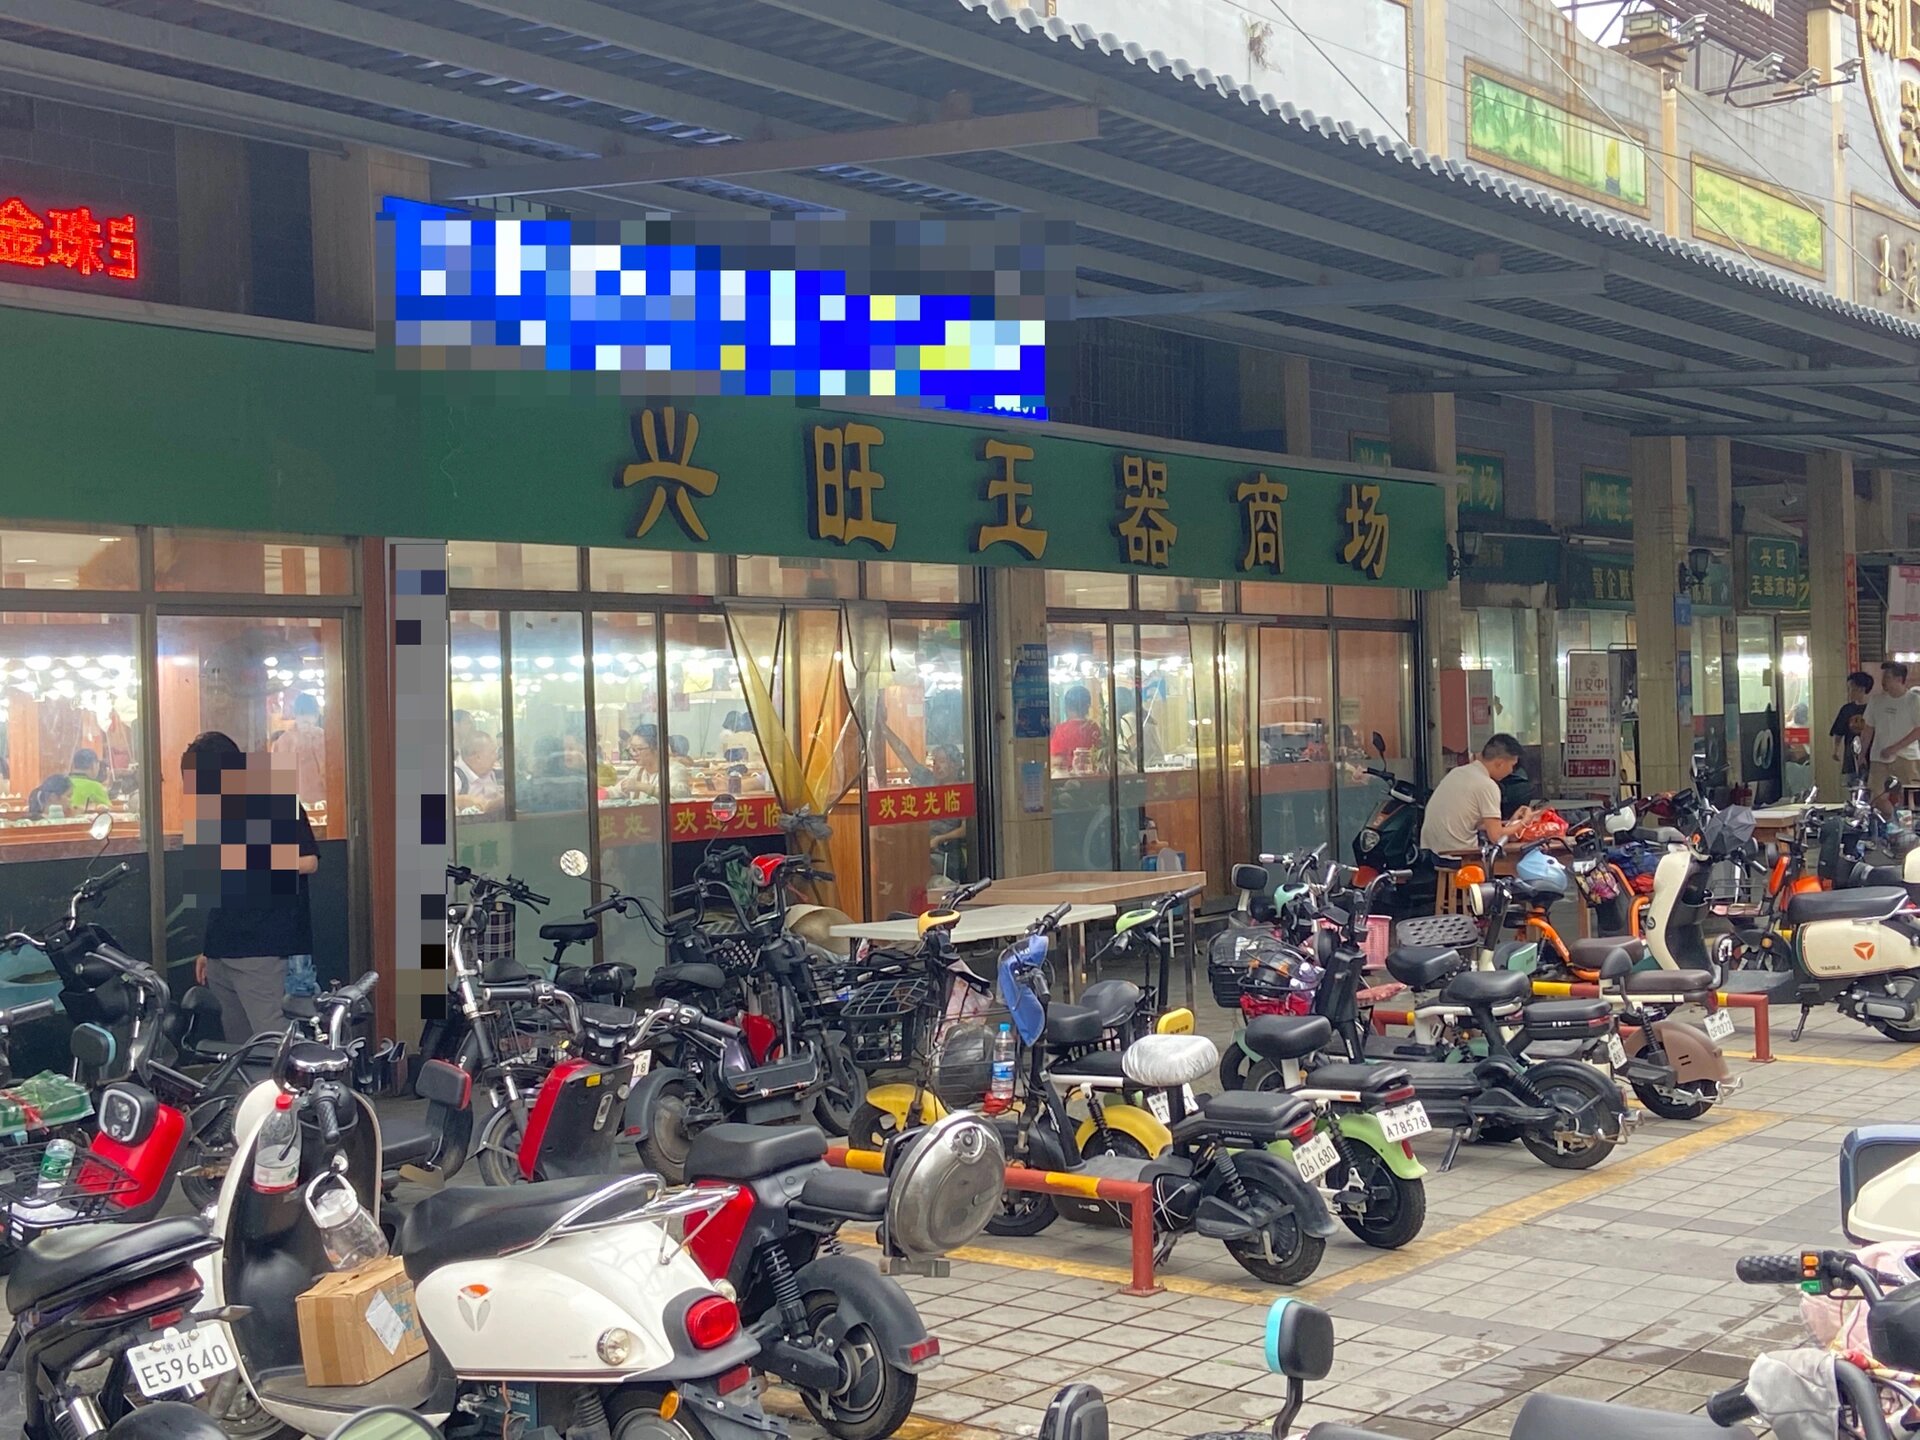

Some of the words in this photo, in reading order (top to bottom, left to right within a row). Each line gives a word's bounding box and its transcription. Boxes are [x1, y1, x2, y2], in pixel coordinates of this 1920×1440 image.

[622, 406, 1390, 579] 兴旺玉器商场
[1587, 480, 1632, 524] 兴旺
[1759, 546, 1788, 570] 兴旺
[878, 789, 961, 819] 欢迎光临
[1386, 1115, 1429, 1138] A78578
[140, 1344, 228, 1389] E59640
